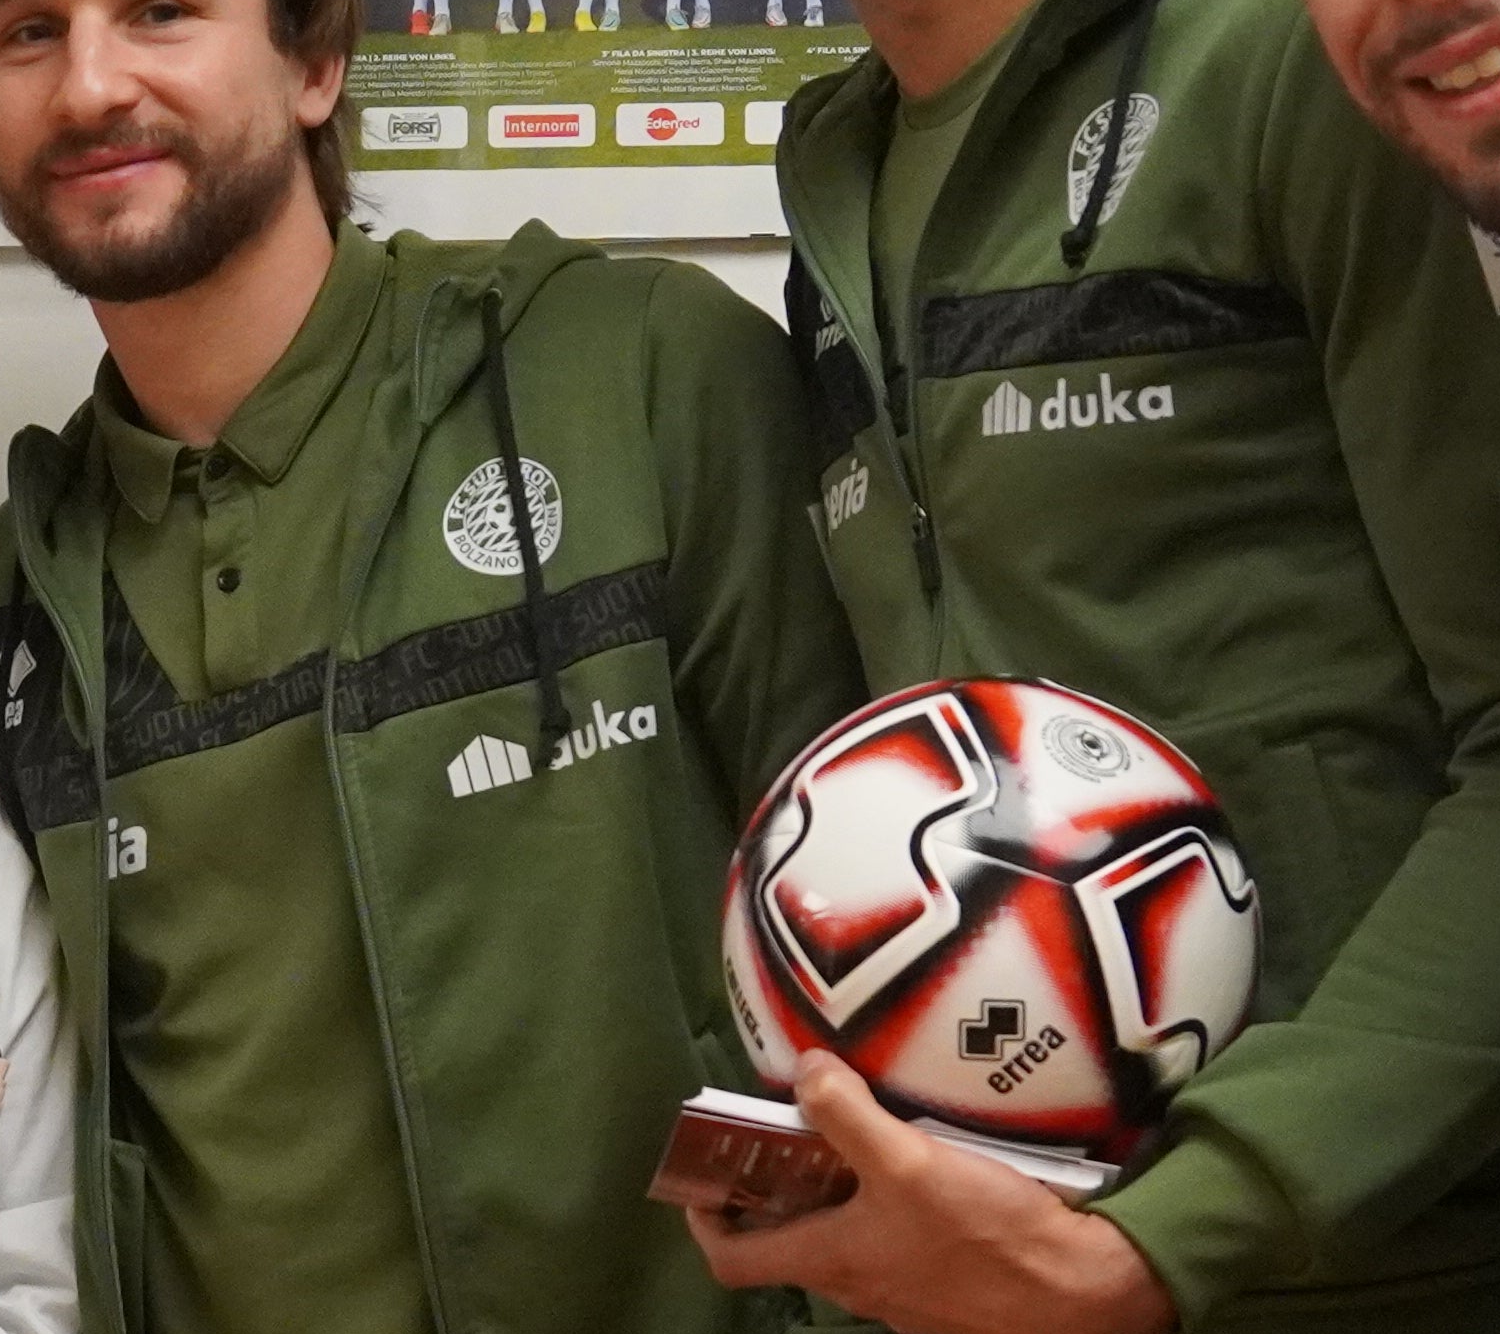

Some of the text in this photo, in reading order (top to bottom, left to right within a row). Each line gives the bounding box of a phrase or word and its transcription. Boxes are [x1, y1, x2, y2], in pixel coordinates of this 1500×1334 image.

[408, 53, 428, 61] VON
[611, 49, 631, 57] FILA
[632, 49, 646, 57] DA
[646, 48, 686, 57] SINISTRA
[728, 48, 747, 56] VON
[817, 46, 836, 54] FILA
[838, 46, 852, 54] DA
[393, 121, 437, 135] FORST
[505, 118, 579, 133] Internorm
[646, 117, 700, 130] Edenred
[1040, 372, 1177, 431] duka
[449, 496, 469, 519] FC
[453, 534, 519, 568] BOLZANO
